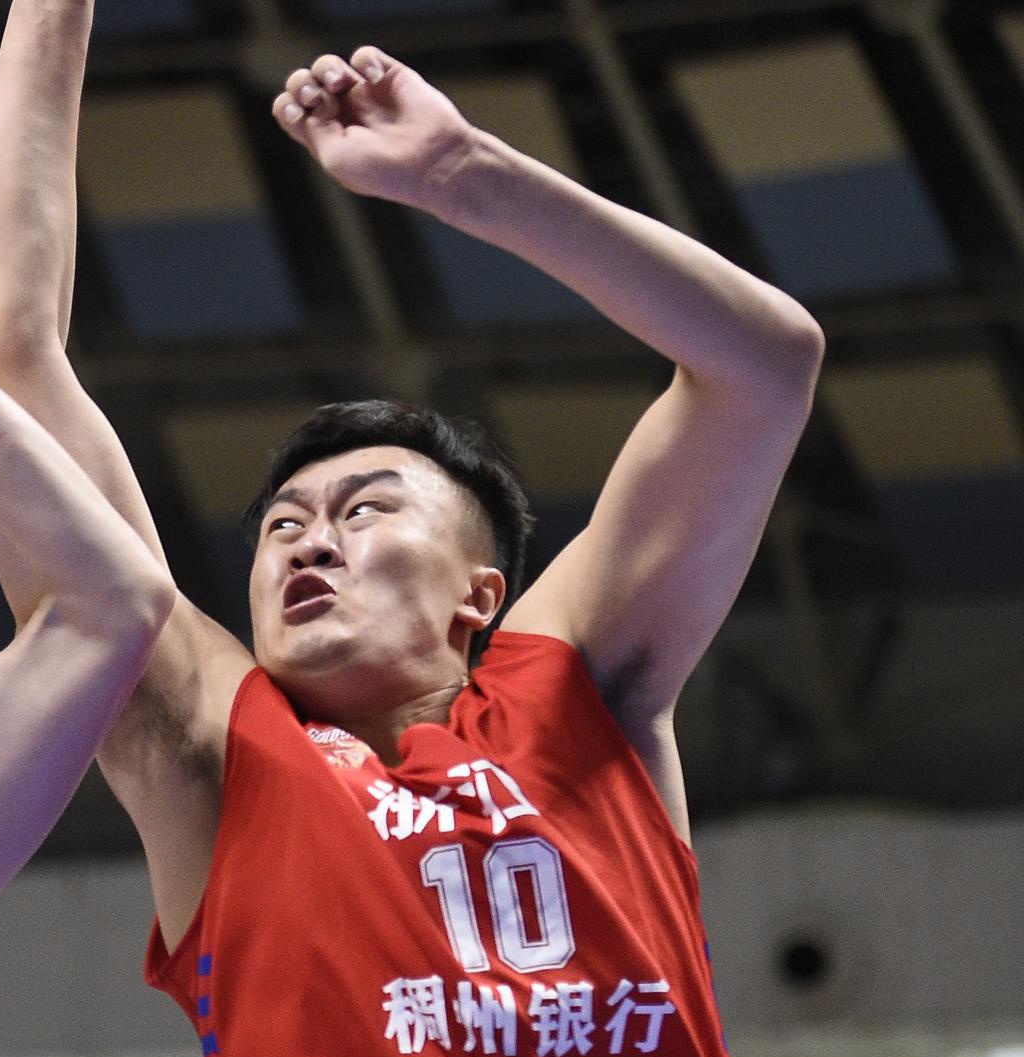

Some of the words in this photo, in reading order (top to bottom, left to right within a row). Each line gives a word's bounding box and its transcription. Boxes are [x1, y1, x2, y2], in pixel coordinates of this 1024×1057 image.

[367, 759, 540, 840] 浙江
[419, 836, 576, 974] 10
[383, 974, 676, 1057] 稠州银行
